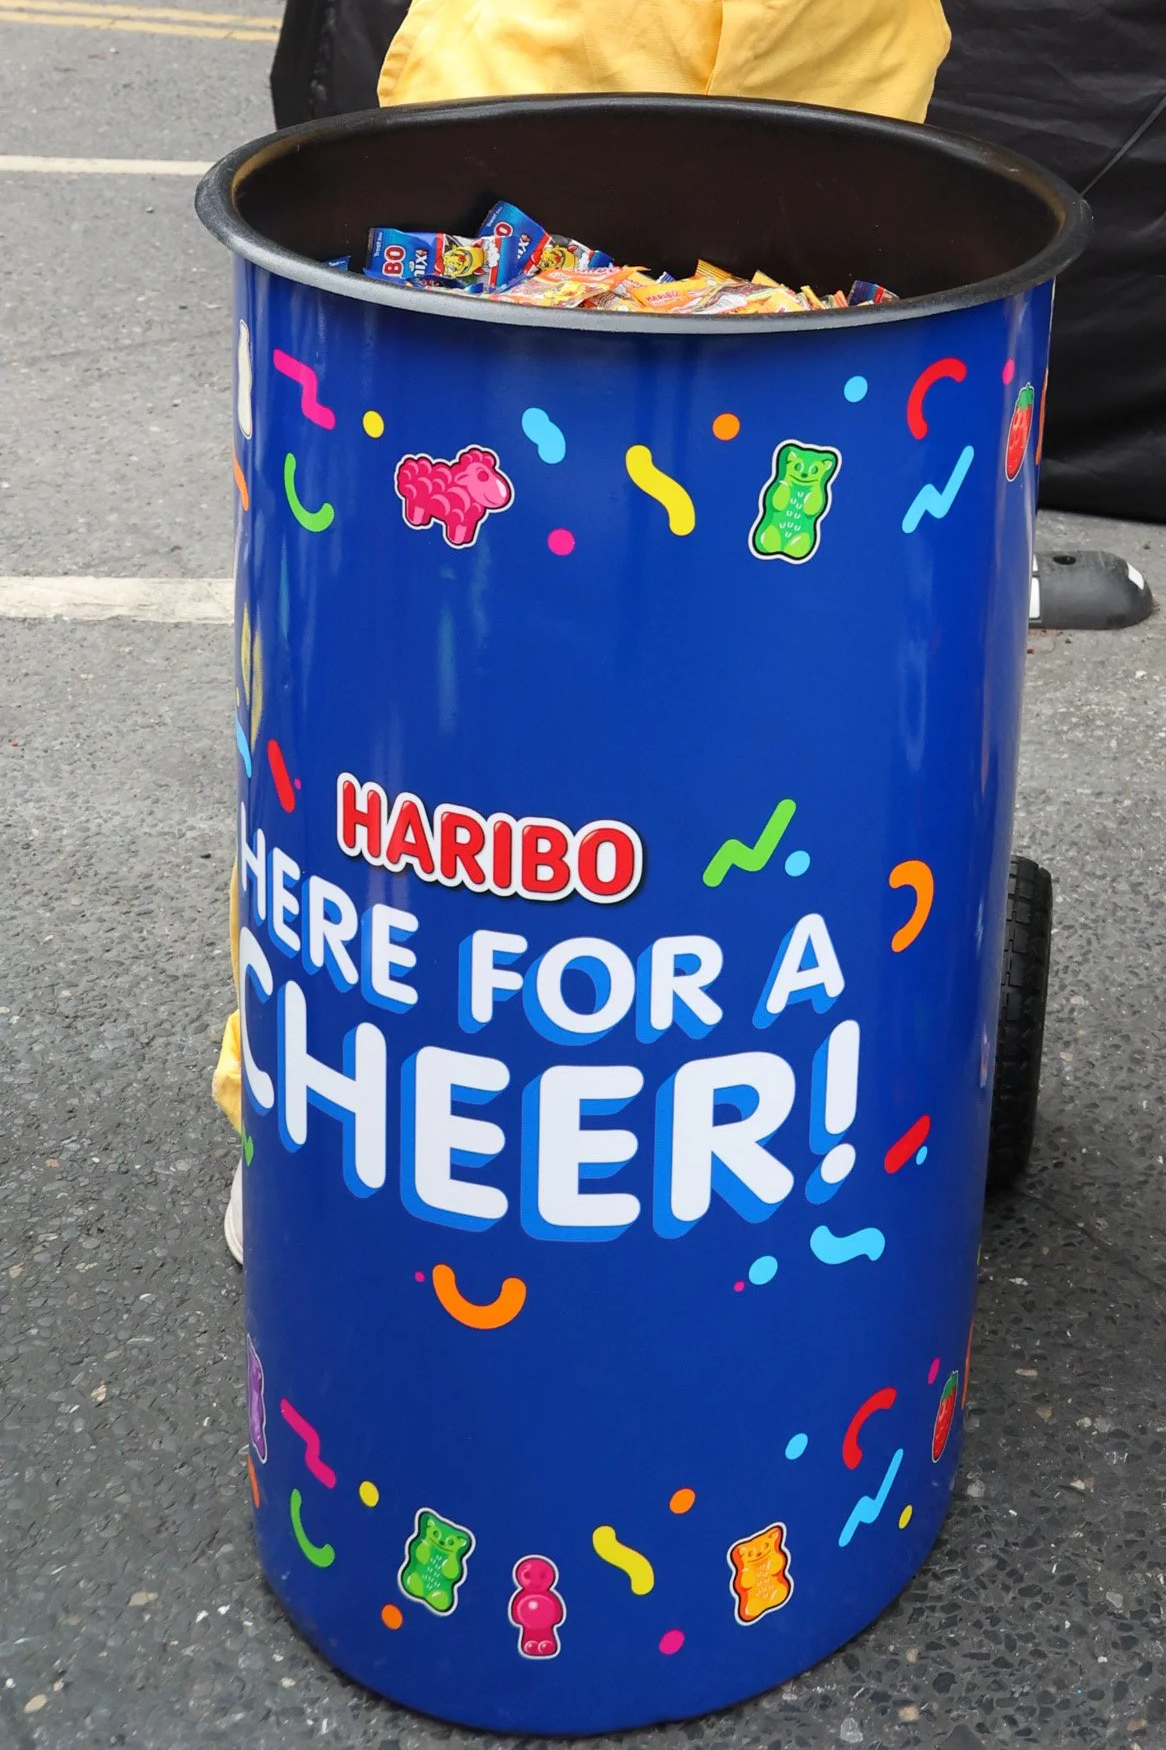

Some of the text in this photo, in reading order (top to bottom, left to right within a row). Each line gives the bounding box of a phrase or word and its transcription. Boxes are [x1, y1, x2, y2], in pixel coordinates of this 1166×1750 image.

[382, 244, 406, 278] BO
[241, 801, 845, 1044] HERE FOR A
[337, 772, 644, 904] HARIBO
[240, 926, 861, 1242] CHEER!
